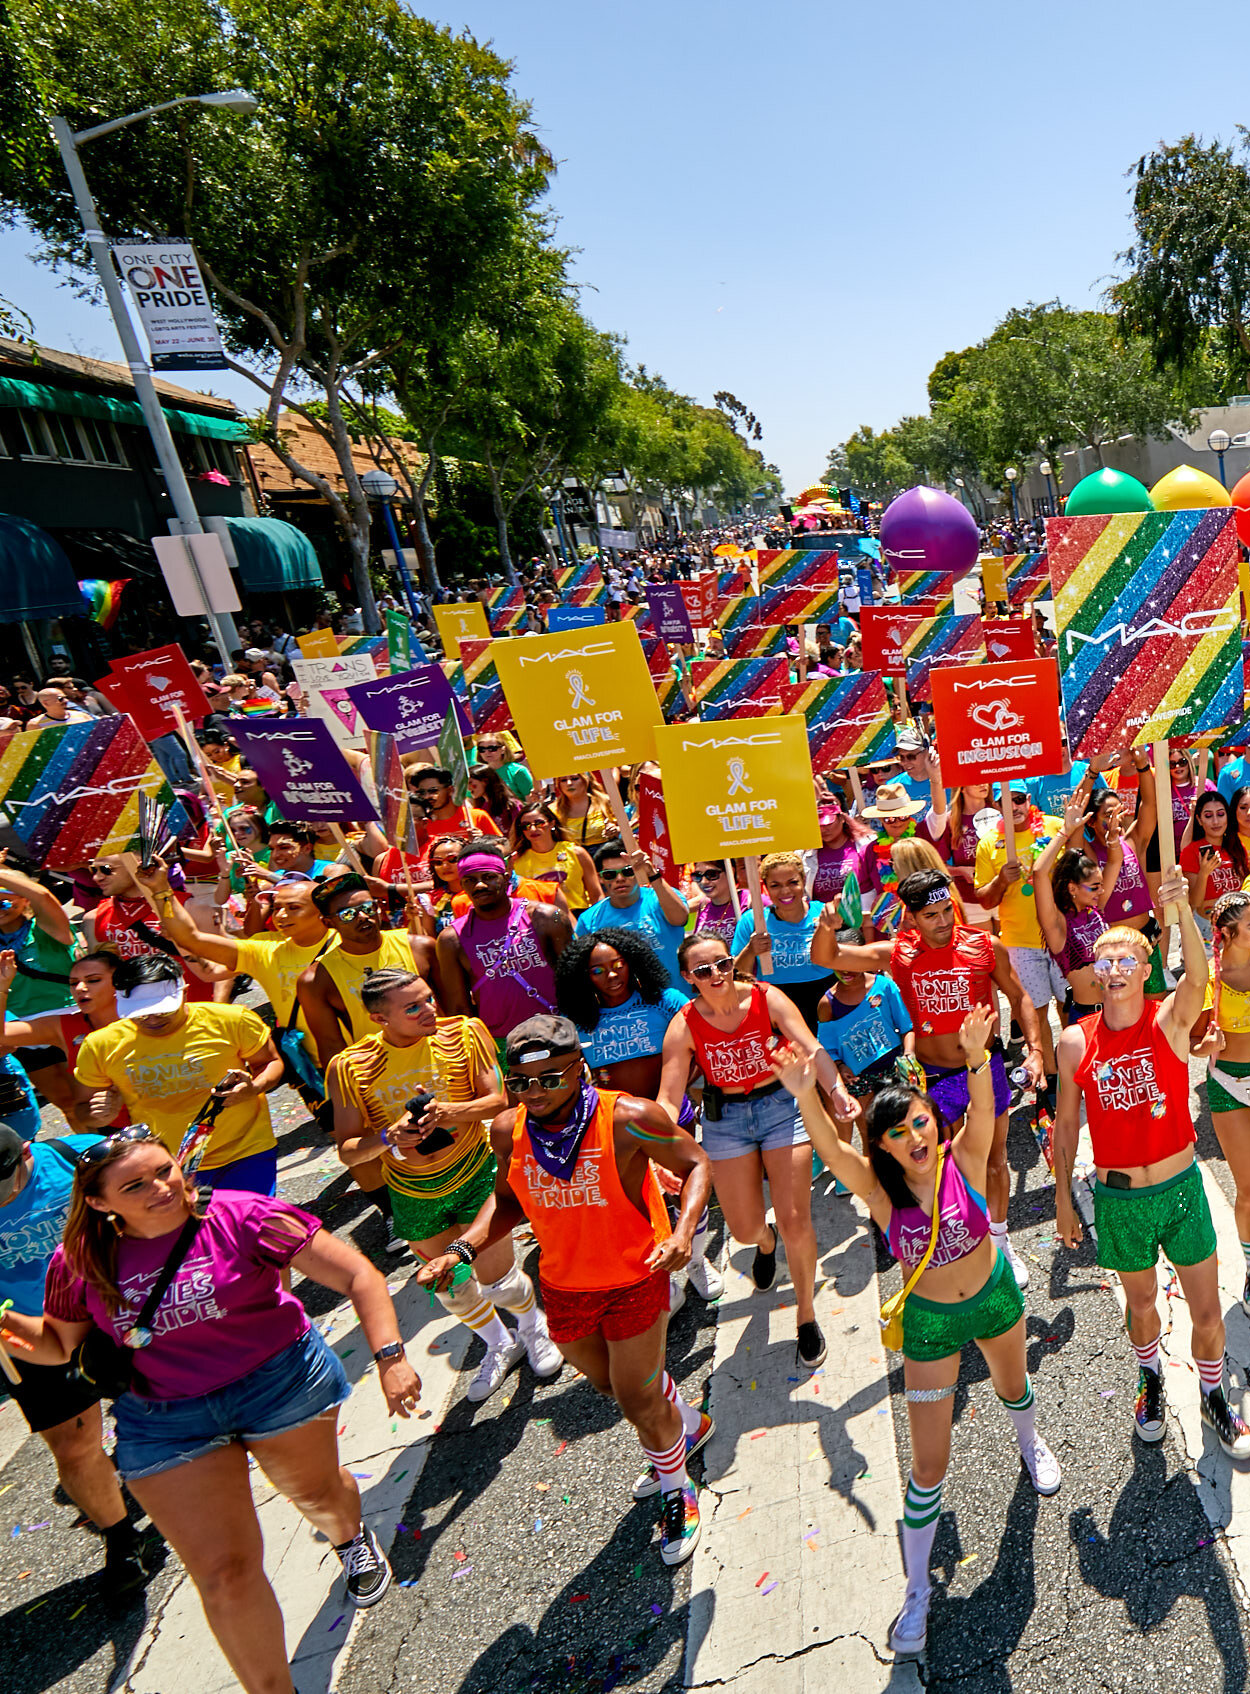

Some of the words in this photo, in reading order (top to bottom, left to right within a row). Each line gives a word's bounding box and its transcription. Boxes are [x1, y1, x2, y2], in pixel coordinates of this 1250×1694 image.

[122, 254, 155, 265] ONE
[160, 253, 191, 265] CITY
[127, 265, 201, 290] ONE
[136, 290, 206, 308] PRIDE
[883, 549, 927, 559] AC
[395, 718, 422, 731] GLAM
[421, 712, 442, 724] FOR
[553, 713, 594, 731] GLAM
[595, 709, 623, 726] FOR
[1126, 706, 1193, 728] #MACLOVESPRIDE
[570, 727, 615, 747] LIFE
[970, 735, 1007, 749] GLAM
[1007, 732, 1031, 746] FOR
[957, 741, 1044, 766] INCLUSION
[286, 781, 313, 791] GLAM
[314, 781, 336, 791] FOR
[705, 801, 747, 816] GLAM
[749, 798, 778, 813] FOR
[720, 814, 764, 832] LIFE
[1214, 878, 1242, 894] PRID
[914, 978, 971, 999] LOVES
[917, 995, 972, 1016] PRIDE
[590, 1018, 650, 1046] LOVES
[594, 1035, 656, 1062] PRIDE
[706, 1042, 764, 1071] LOVES
[126, 1058, 205, 1085] LOVES
[712, 1059, 770, 1084] PRIDE
[1097, 1062, 1157, 1093] LOVES
[133, 1074, 213, 1098] PRIDE
[1099, 1082, 1161, 1111] PRIDE
[525, 1163, 600, 1190] LOES
[529, 1185, 606, 1210] PRIDE
